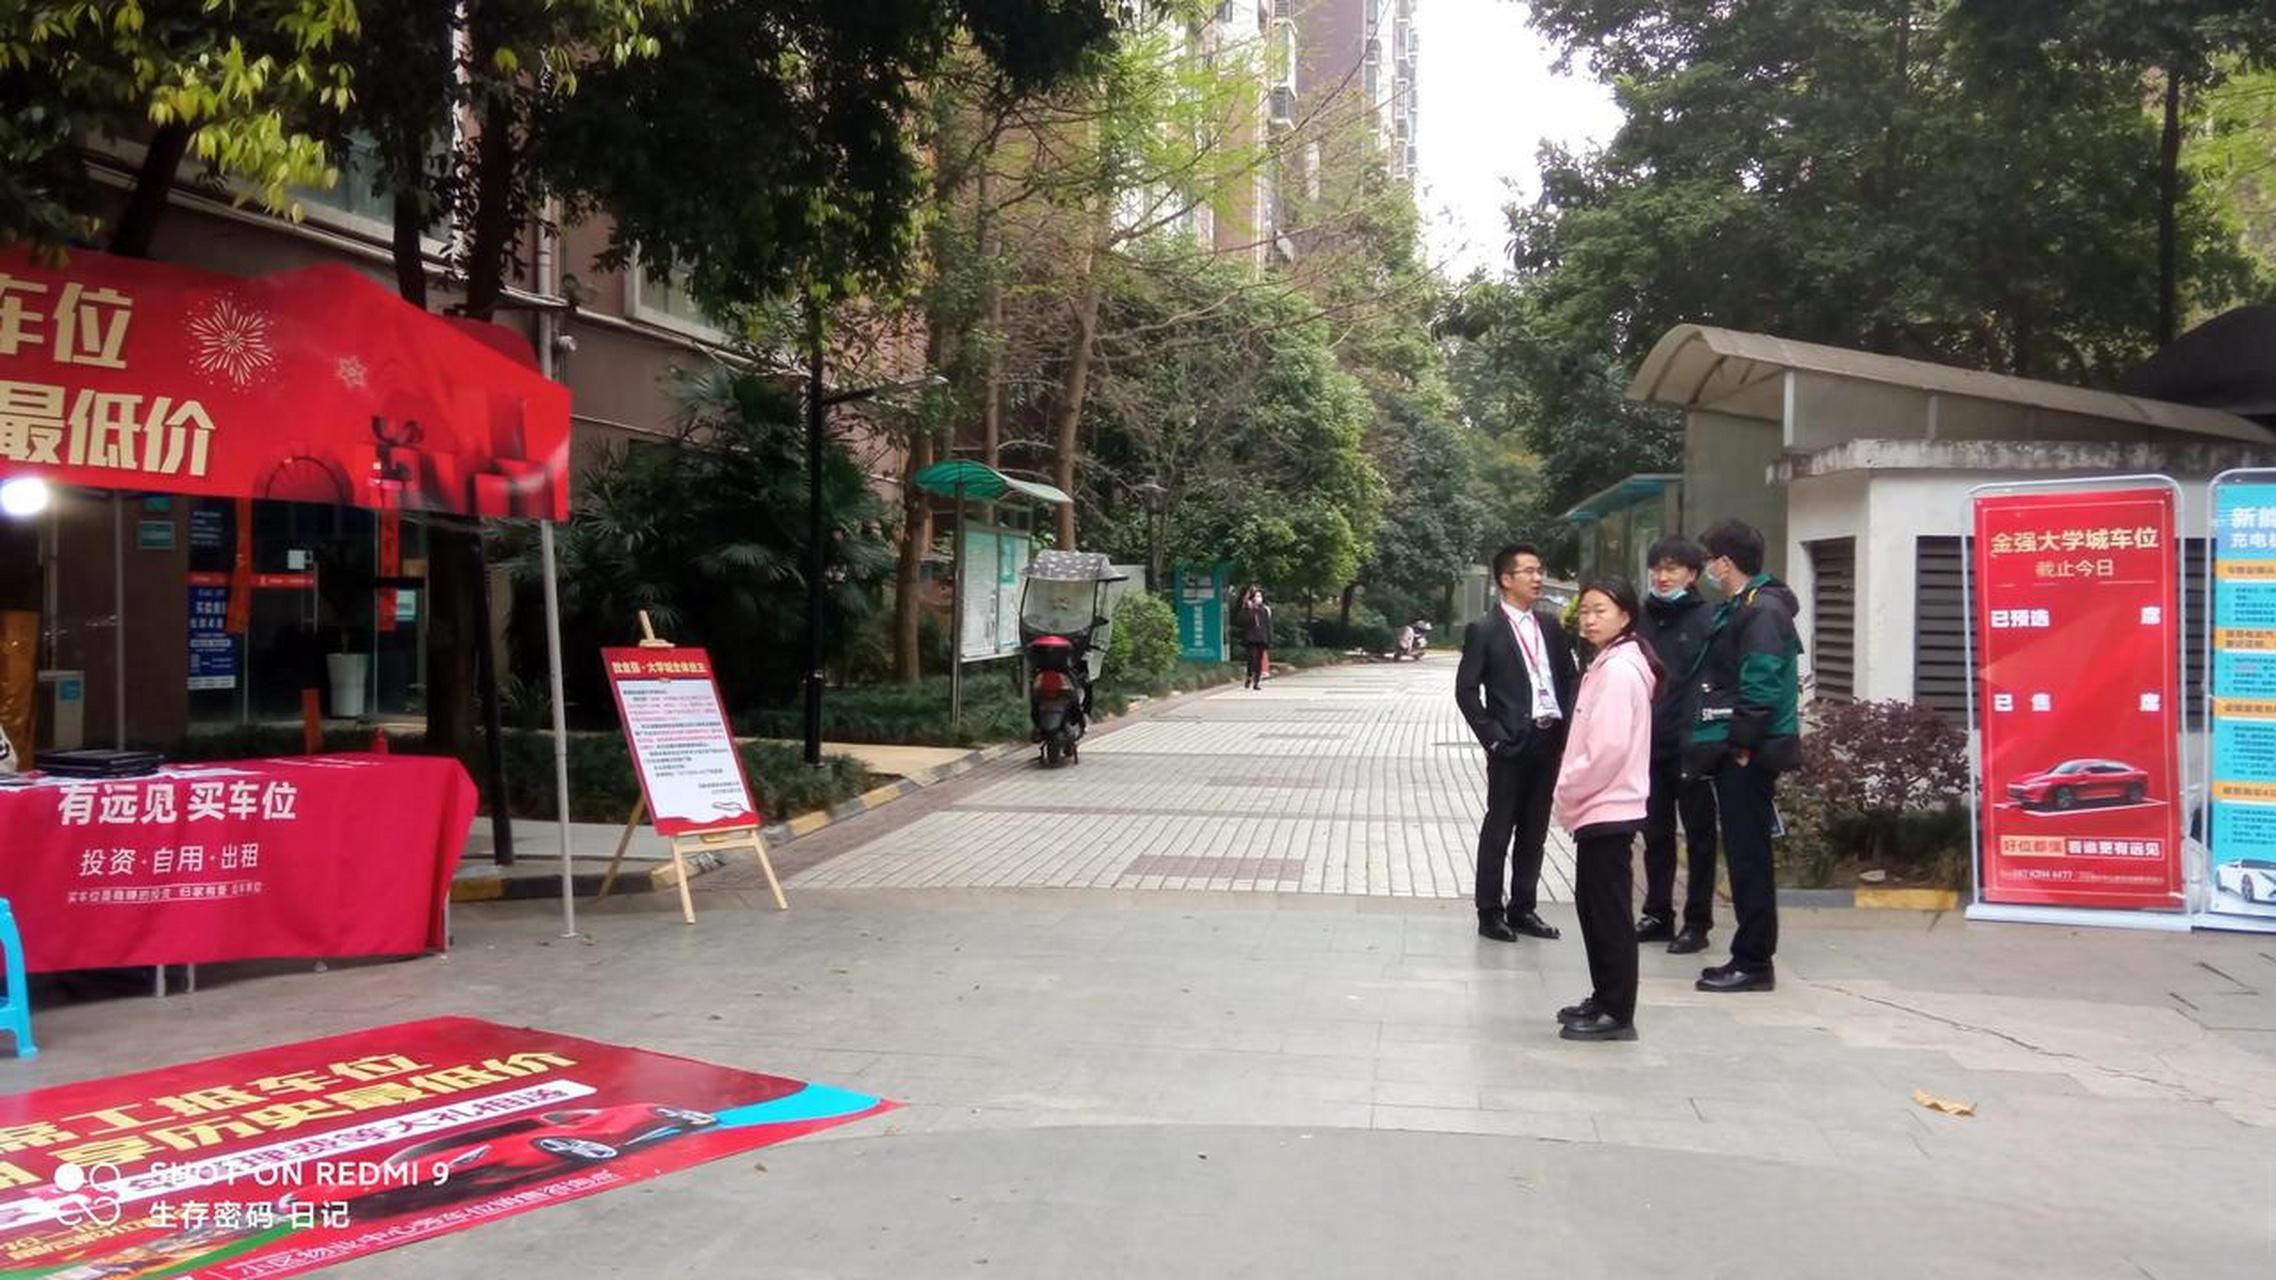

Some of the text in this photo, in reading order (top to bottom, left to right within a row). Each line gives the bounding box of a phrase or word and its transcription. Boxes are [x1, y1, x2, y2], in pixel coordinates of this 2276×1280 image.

[0, 273, 133, 370] 车位
[0, 380, 216, 477] 最低价
[1991, 527, 2159, 554] 金强大学城车位
[2035, 559, 2114, 578] 截止今日
[1991, 608, 2049, 628] 已预选
[58, 781, 298, 826] 有远见 买车位
